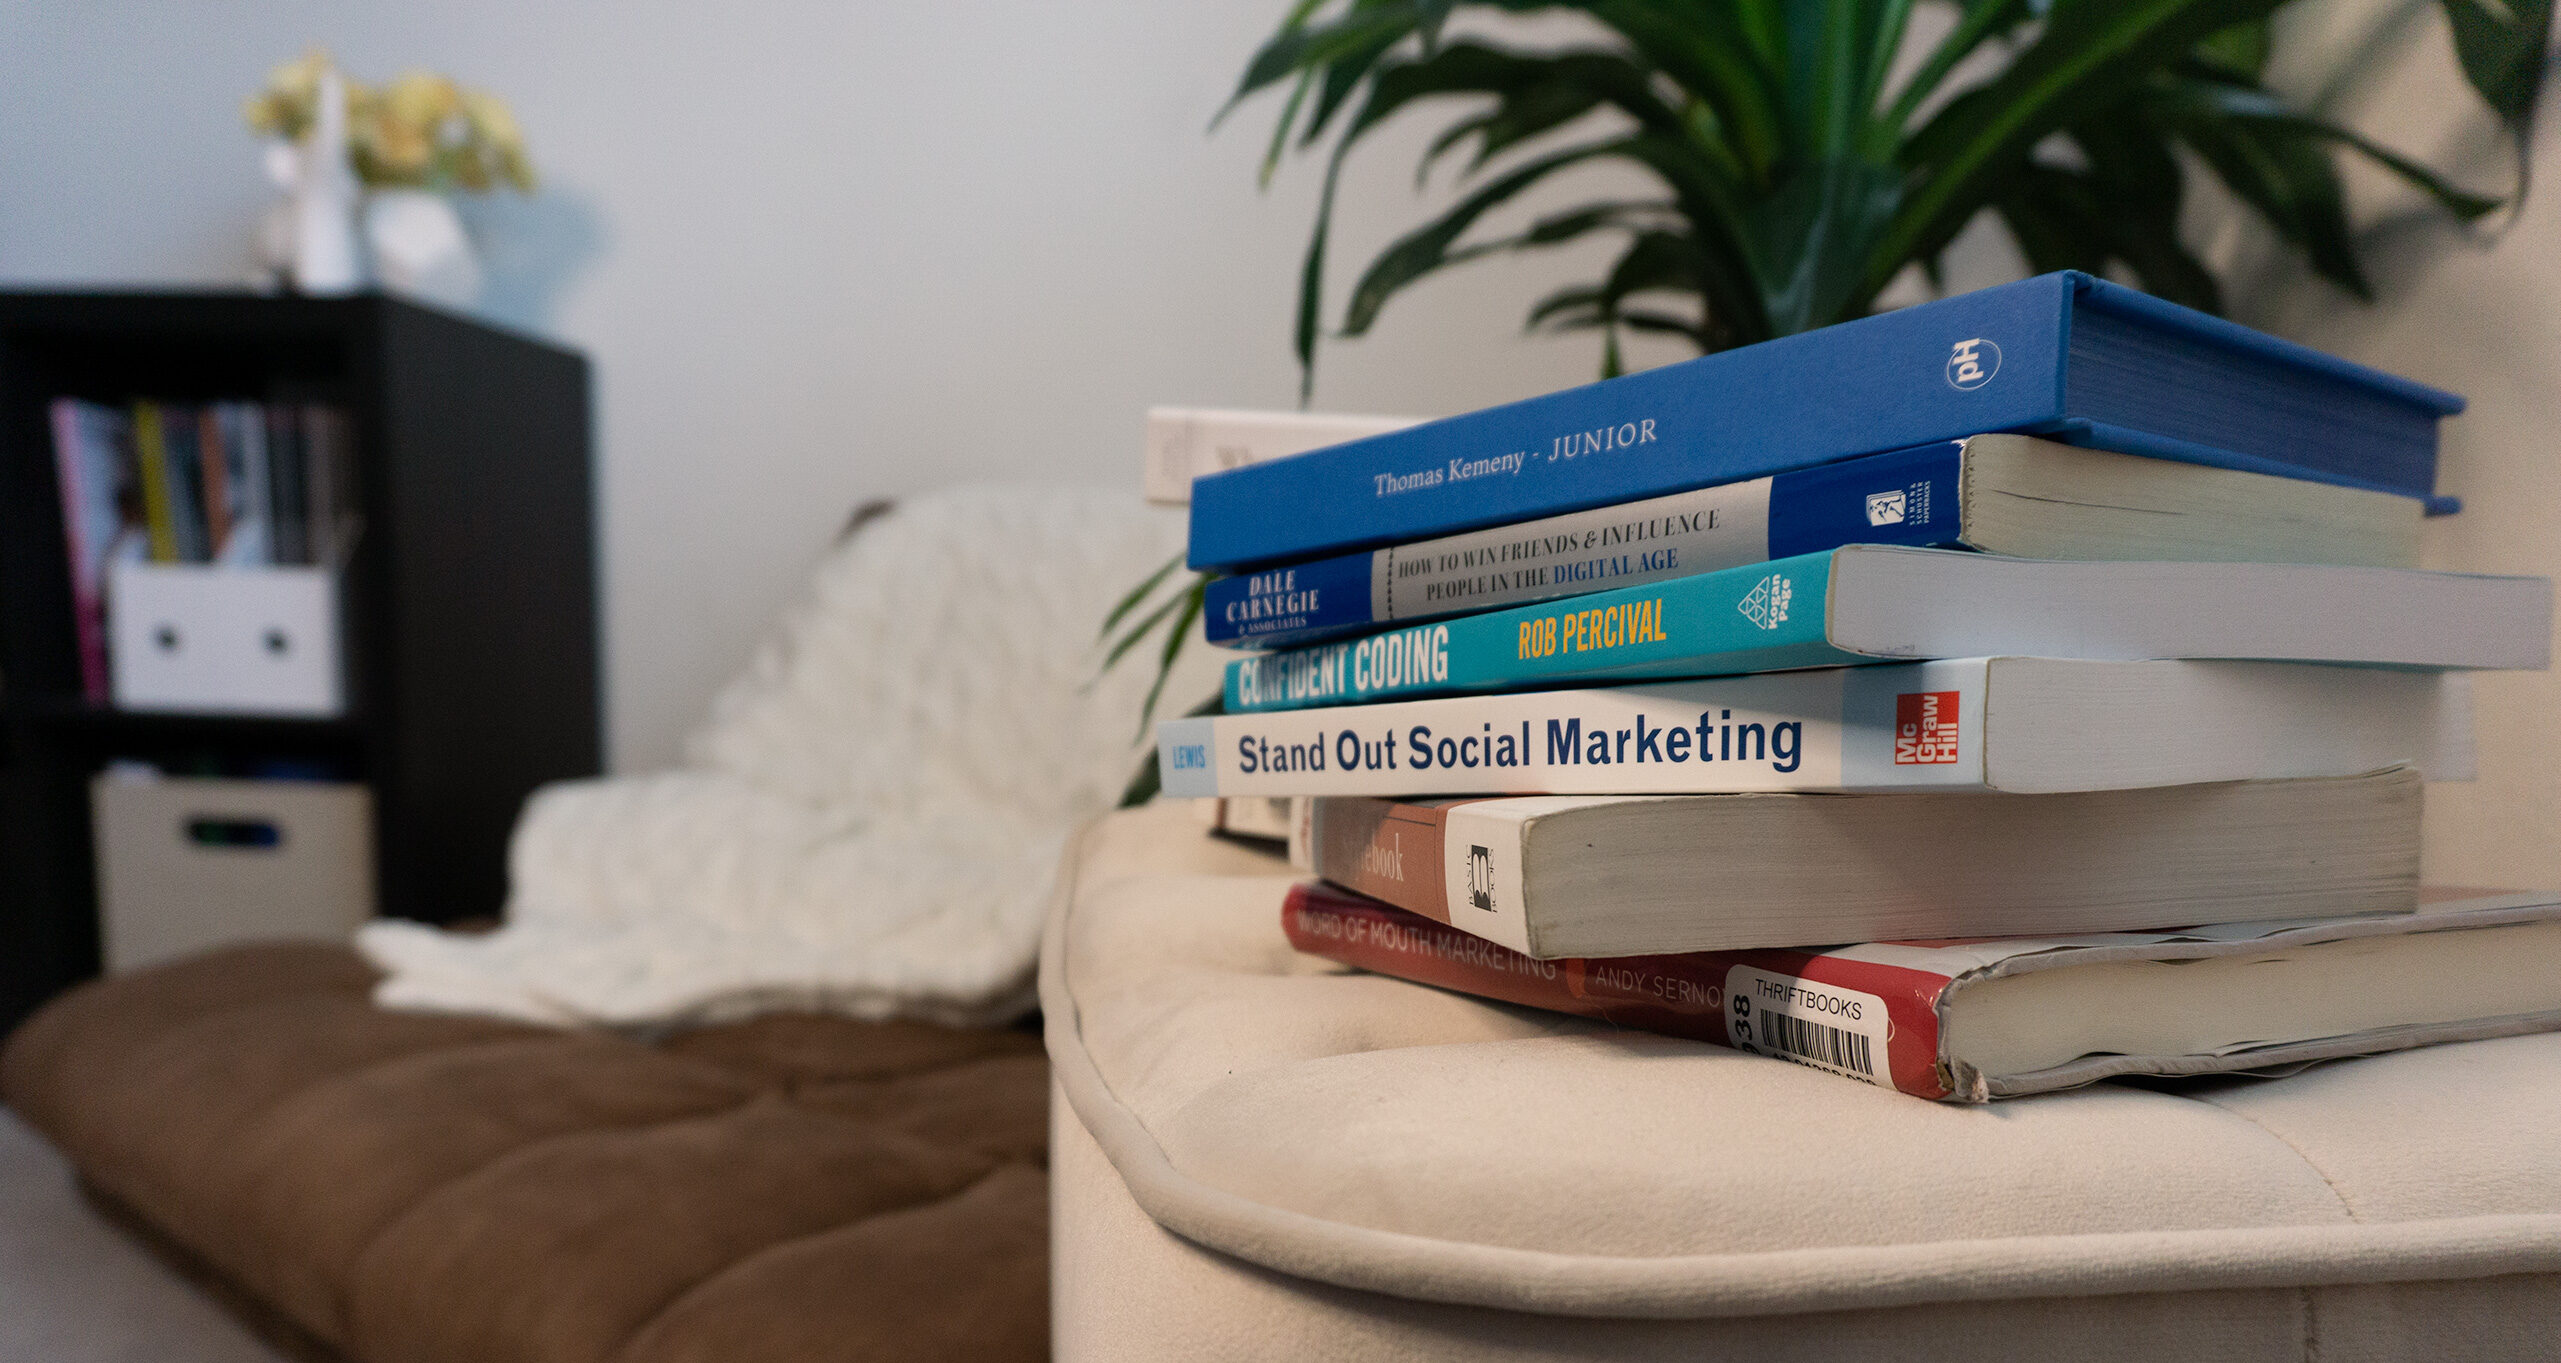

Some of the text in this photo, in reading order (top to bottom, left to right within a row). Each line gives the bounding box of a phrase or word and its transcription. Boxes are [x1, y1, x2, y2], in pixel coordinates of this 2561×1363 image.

[1375, 468, 1443, 496] Thomas
[1448, 451, 1525, 481] Kemeny
[1549, 419, 1657, 461] JUNIOR
[1916, 481, 1924, 525] SCHUSTER
[1399, 509, 1720, 578] HOW TO WIN FRIENDS & INFLUENCE
[1249, 570, 1295, 597] DALE
[1427, 548, 1679, 601] PEOPLE IN THE DIGITAL AGE
[1225, 589, 1319, 624] CARNEGIE
[1768, 574, 1781, 629] Kogan
[1779, 579, 1792, 621] Page
[1248, 616, 1307, 634] ASSOCIATES
[1519, 599, 1666, 660] ROB PERCIVAL
[1238, 625, 1448, 706] CONFIDENT CODING
[1239, 709, 1802, 774] Stand Out Social Marketing
[1896, 723, 1917, 763] Mc
[1916, 695, 1938, 763] Graw
[1936, 722, 1957, 762] Hill
[1173, 745, 1206, 769] LEWIS
[1297, 909, 1556, 980] WORD OF MOUTH MARKETING
[1596, 966, 1646, 993] ANDY
[1755, 979, 1862, 1021] THRIFTBOOKS
